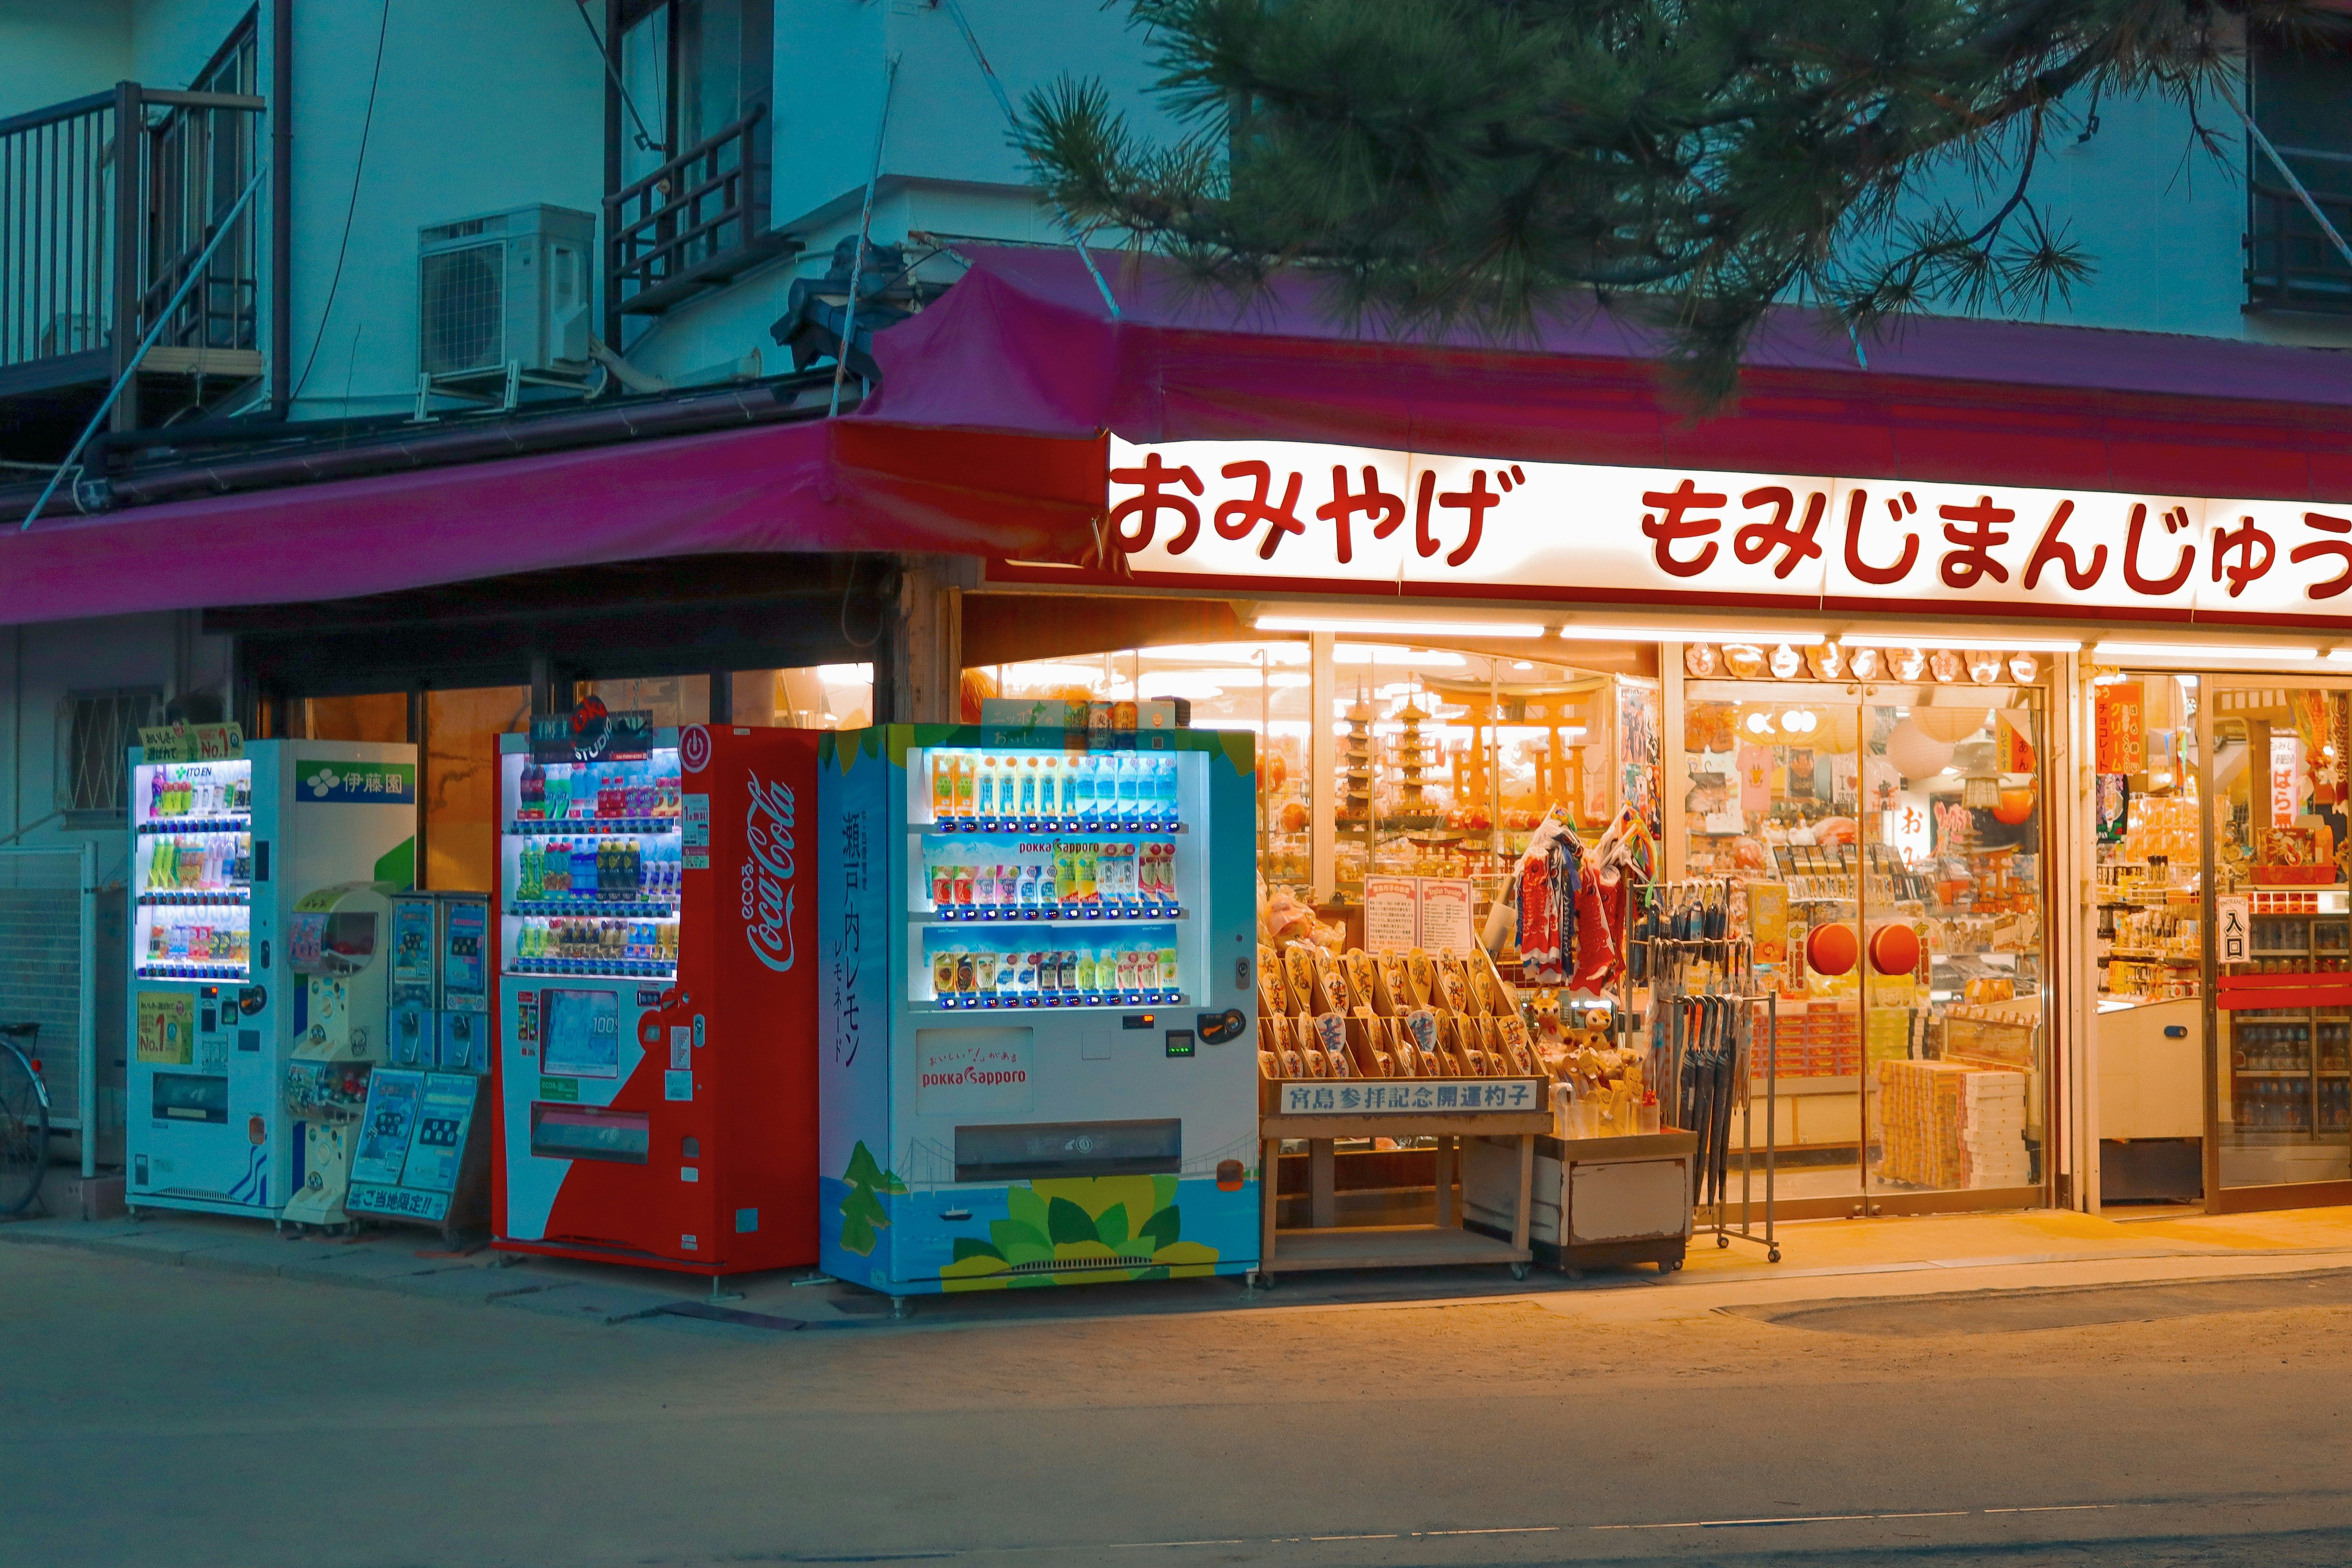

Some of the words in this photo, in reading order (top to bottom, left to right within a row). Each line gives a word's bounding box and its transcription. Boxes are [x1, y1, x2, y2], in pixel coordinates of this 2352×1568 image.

[1111, 453, 1526, 568] おみやげ
[1642, 479, 2352, 600] もみじまんじゅう
[574, 716, 612, 761] STUDIO
[2018, 740, 2029, 771] あん
[2098, 703, 2108, 771] チョコレート
[2110, 702, 2122, 772] クリーム
[186, 767, 200, 778] ITO
[201, 766, 212, 777] EN
[342, 771, 403, 795] 伊藤園
[747, 768, 795, 972] Coca-Cola
[2220, 898, 2247, 907] ENTRANCE
[842, 810, 860, 1068] 瀬戸内レモン
[2225, 912, 2243, 958] 入口
[833, 939, 843, 1064] レモネード
[1290, 1084, 1530, 1110] 宮島参拝記念開運杓子
[363, 1190, 432, 1215] ご当地限定!!
